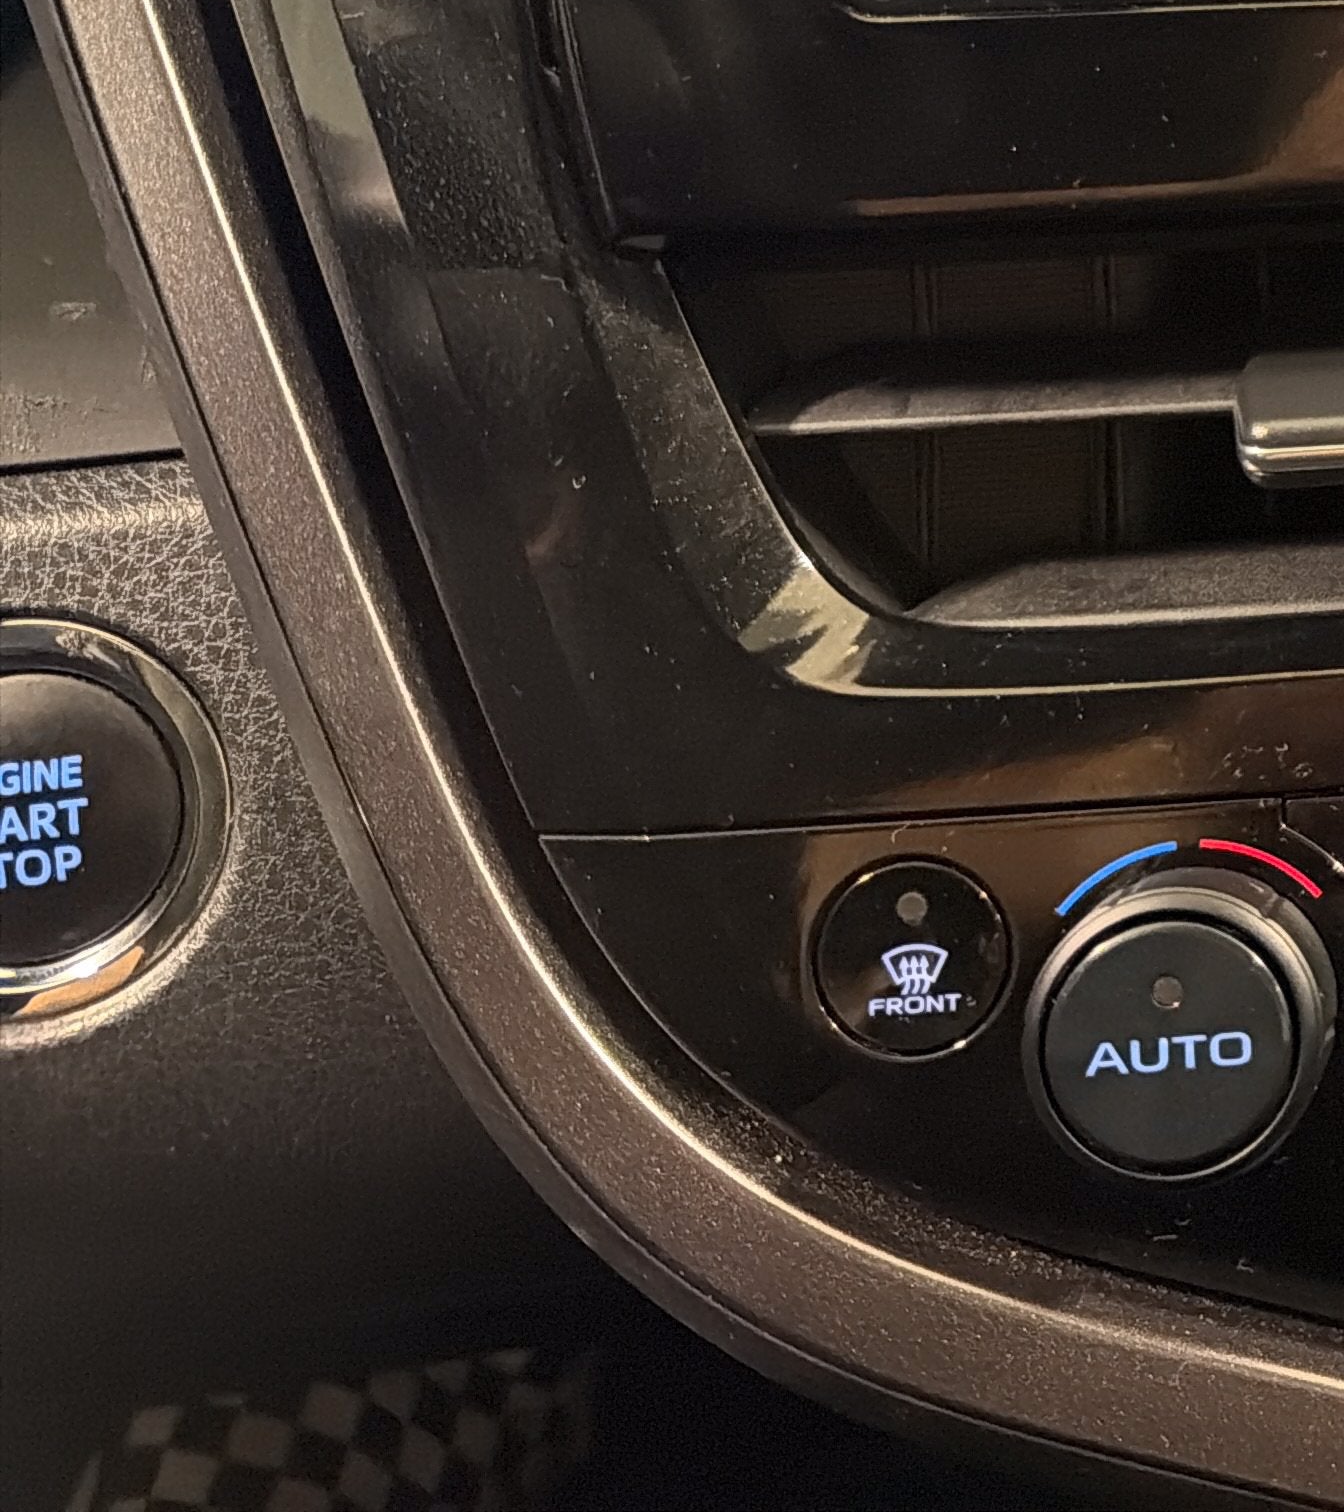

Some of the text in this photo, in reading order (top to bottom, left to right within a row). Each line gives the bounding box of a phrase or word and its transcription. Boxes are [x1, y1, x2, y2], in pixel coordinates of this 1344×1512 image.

[0, 754, 83, 796] GINE
[0, 797, 89, 844] ART
[0, 844, 82, 889] TOP
[868, 992, 962, 1016] FRONT
[1085, 1031, 1252, 1077] AUTO
